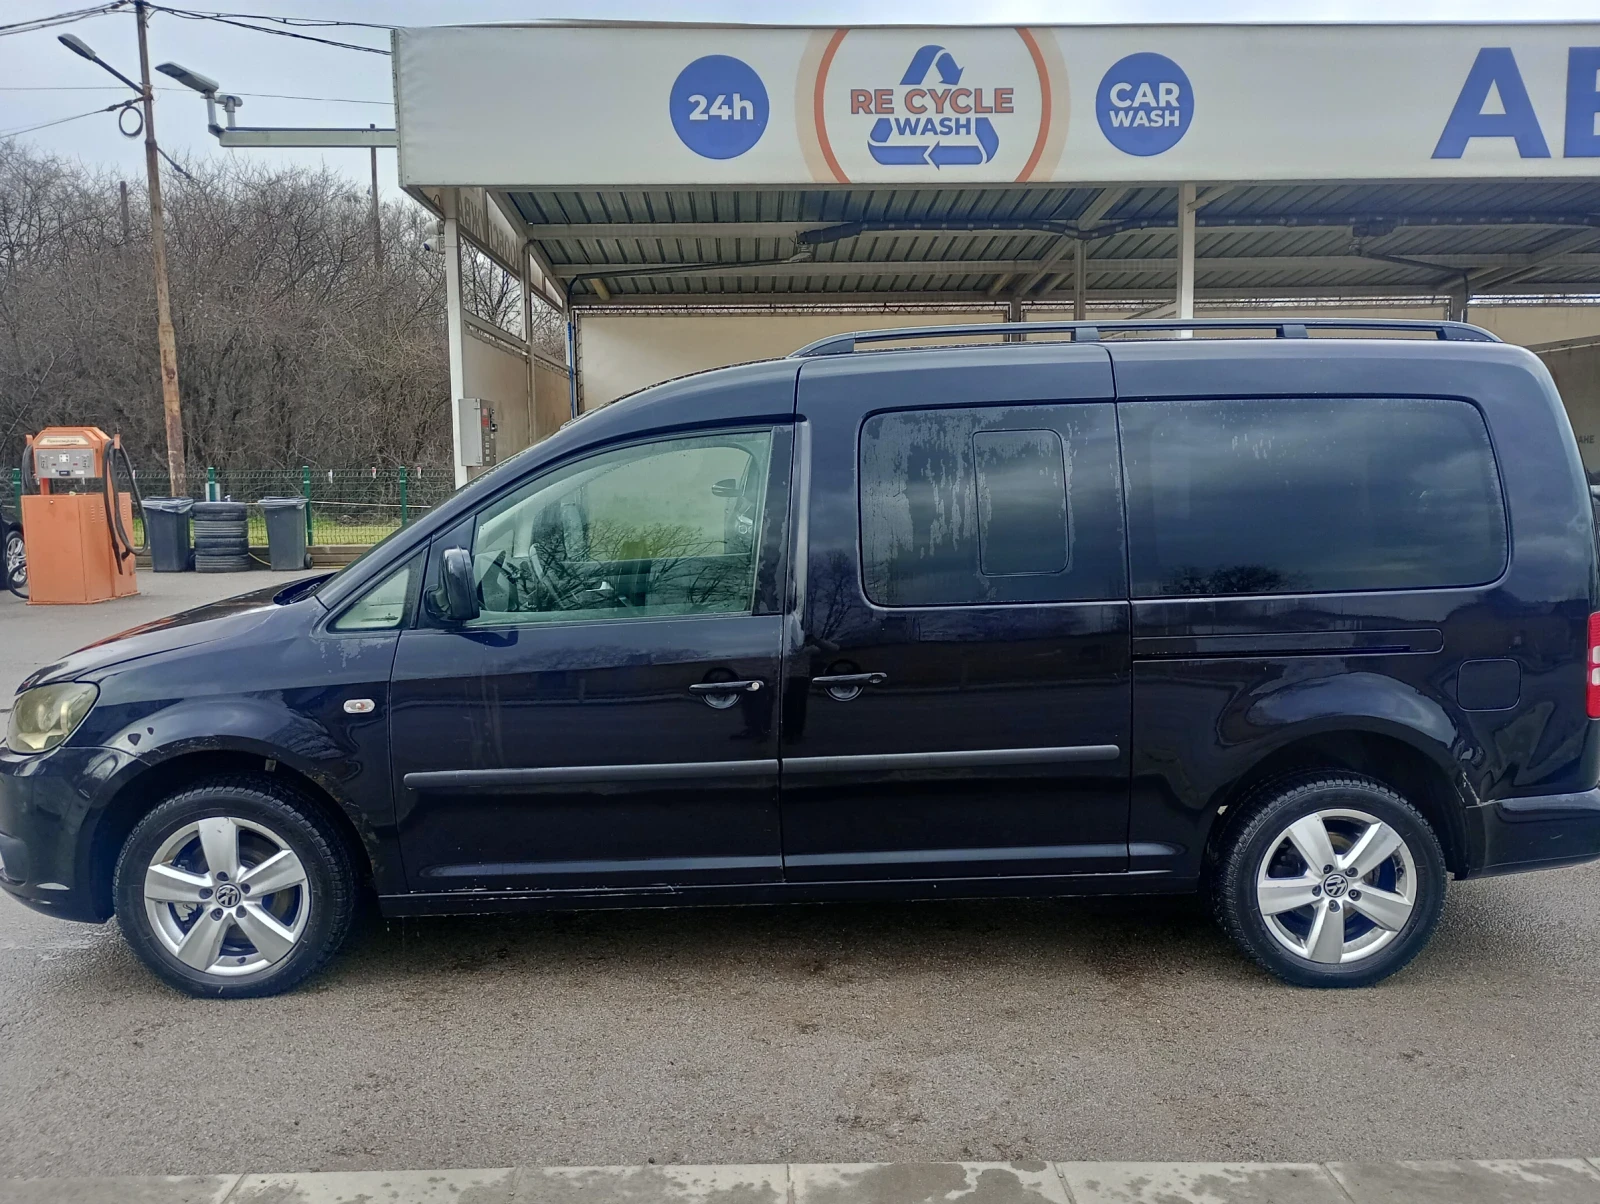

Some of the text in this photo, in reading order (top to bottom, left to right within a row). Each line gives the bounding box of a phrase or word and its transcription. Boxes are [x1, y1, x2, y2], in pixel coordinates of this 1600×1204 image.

[687, 93, 754, 120] 24h
[850, 87, 1014, 115] RE CYCLE
[1109, 82, 1180, 108] CAR
[894, 117, 972, 136] WASH
[1109, 110, 1180, 128] WASH
